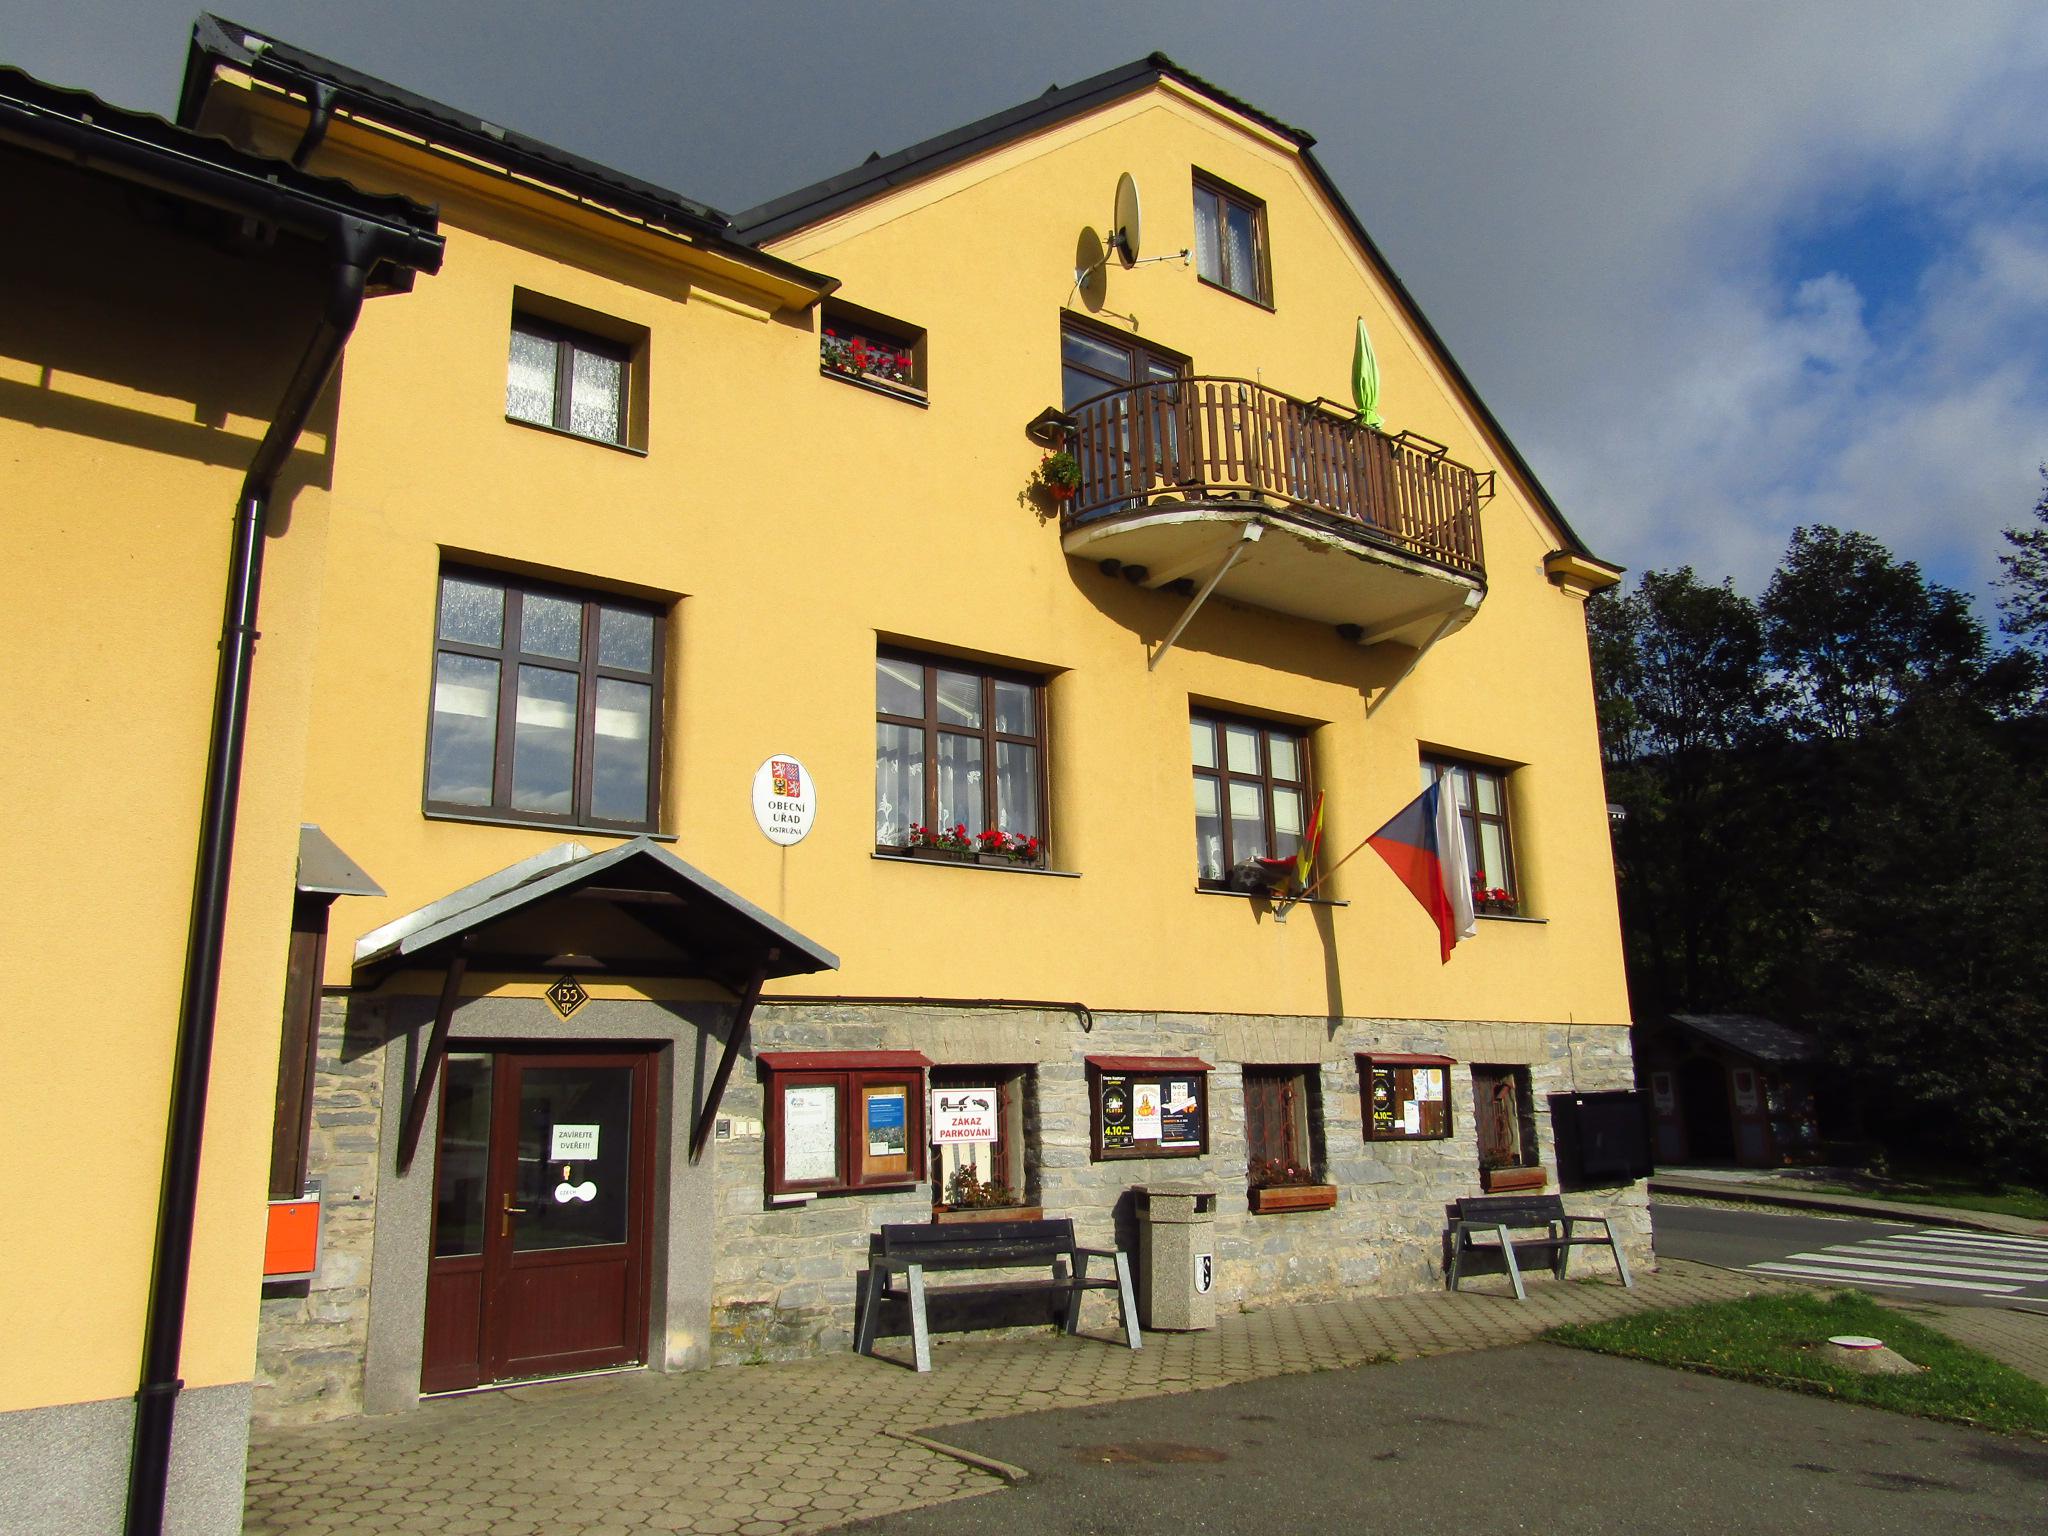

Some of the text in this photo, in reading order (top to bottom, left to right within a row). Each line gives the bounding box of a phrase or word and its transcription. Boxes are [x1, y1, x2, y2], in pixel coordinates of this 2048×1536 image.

[768, 801, 805, 813] OBECNÍ
[558, 988, 578, 1002] 135
[952, 1116, 982, 1126] ZÁKAZ
[559, 1131, 593, 1139] ZAVÍREJTE
[940, 1127, 991, 1138] PARKOVÁNÍ
